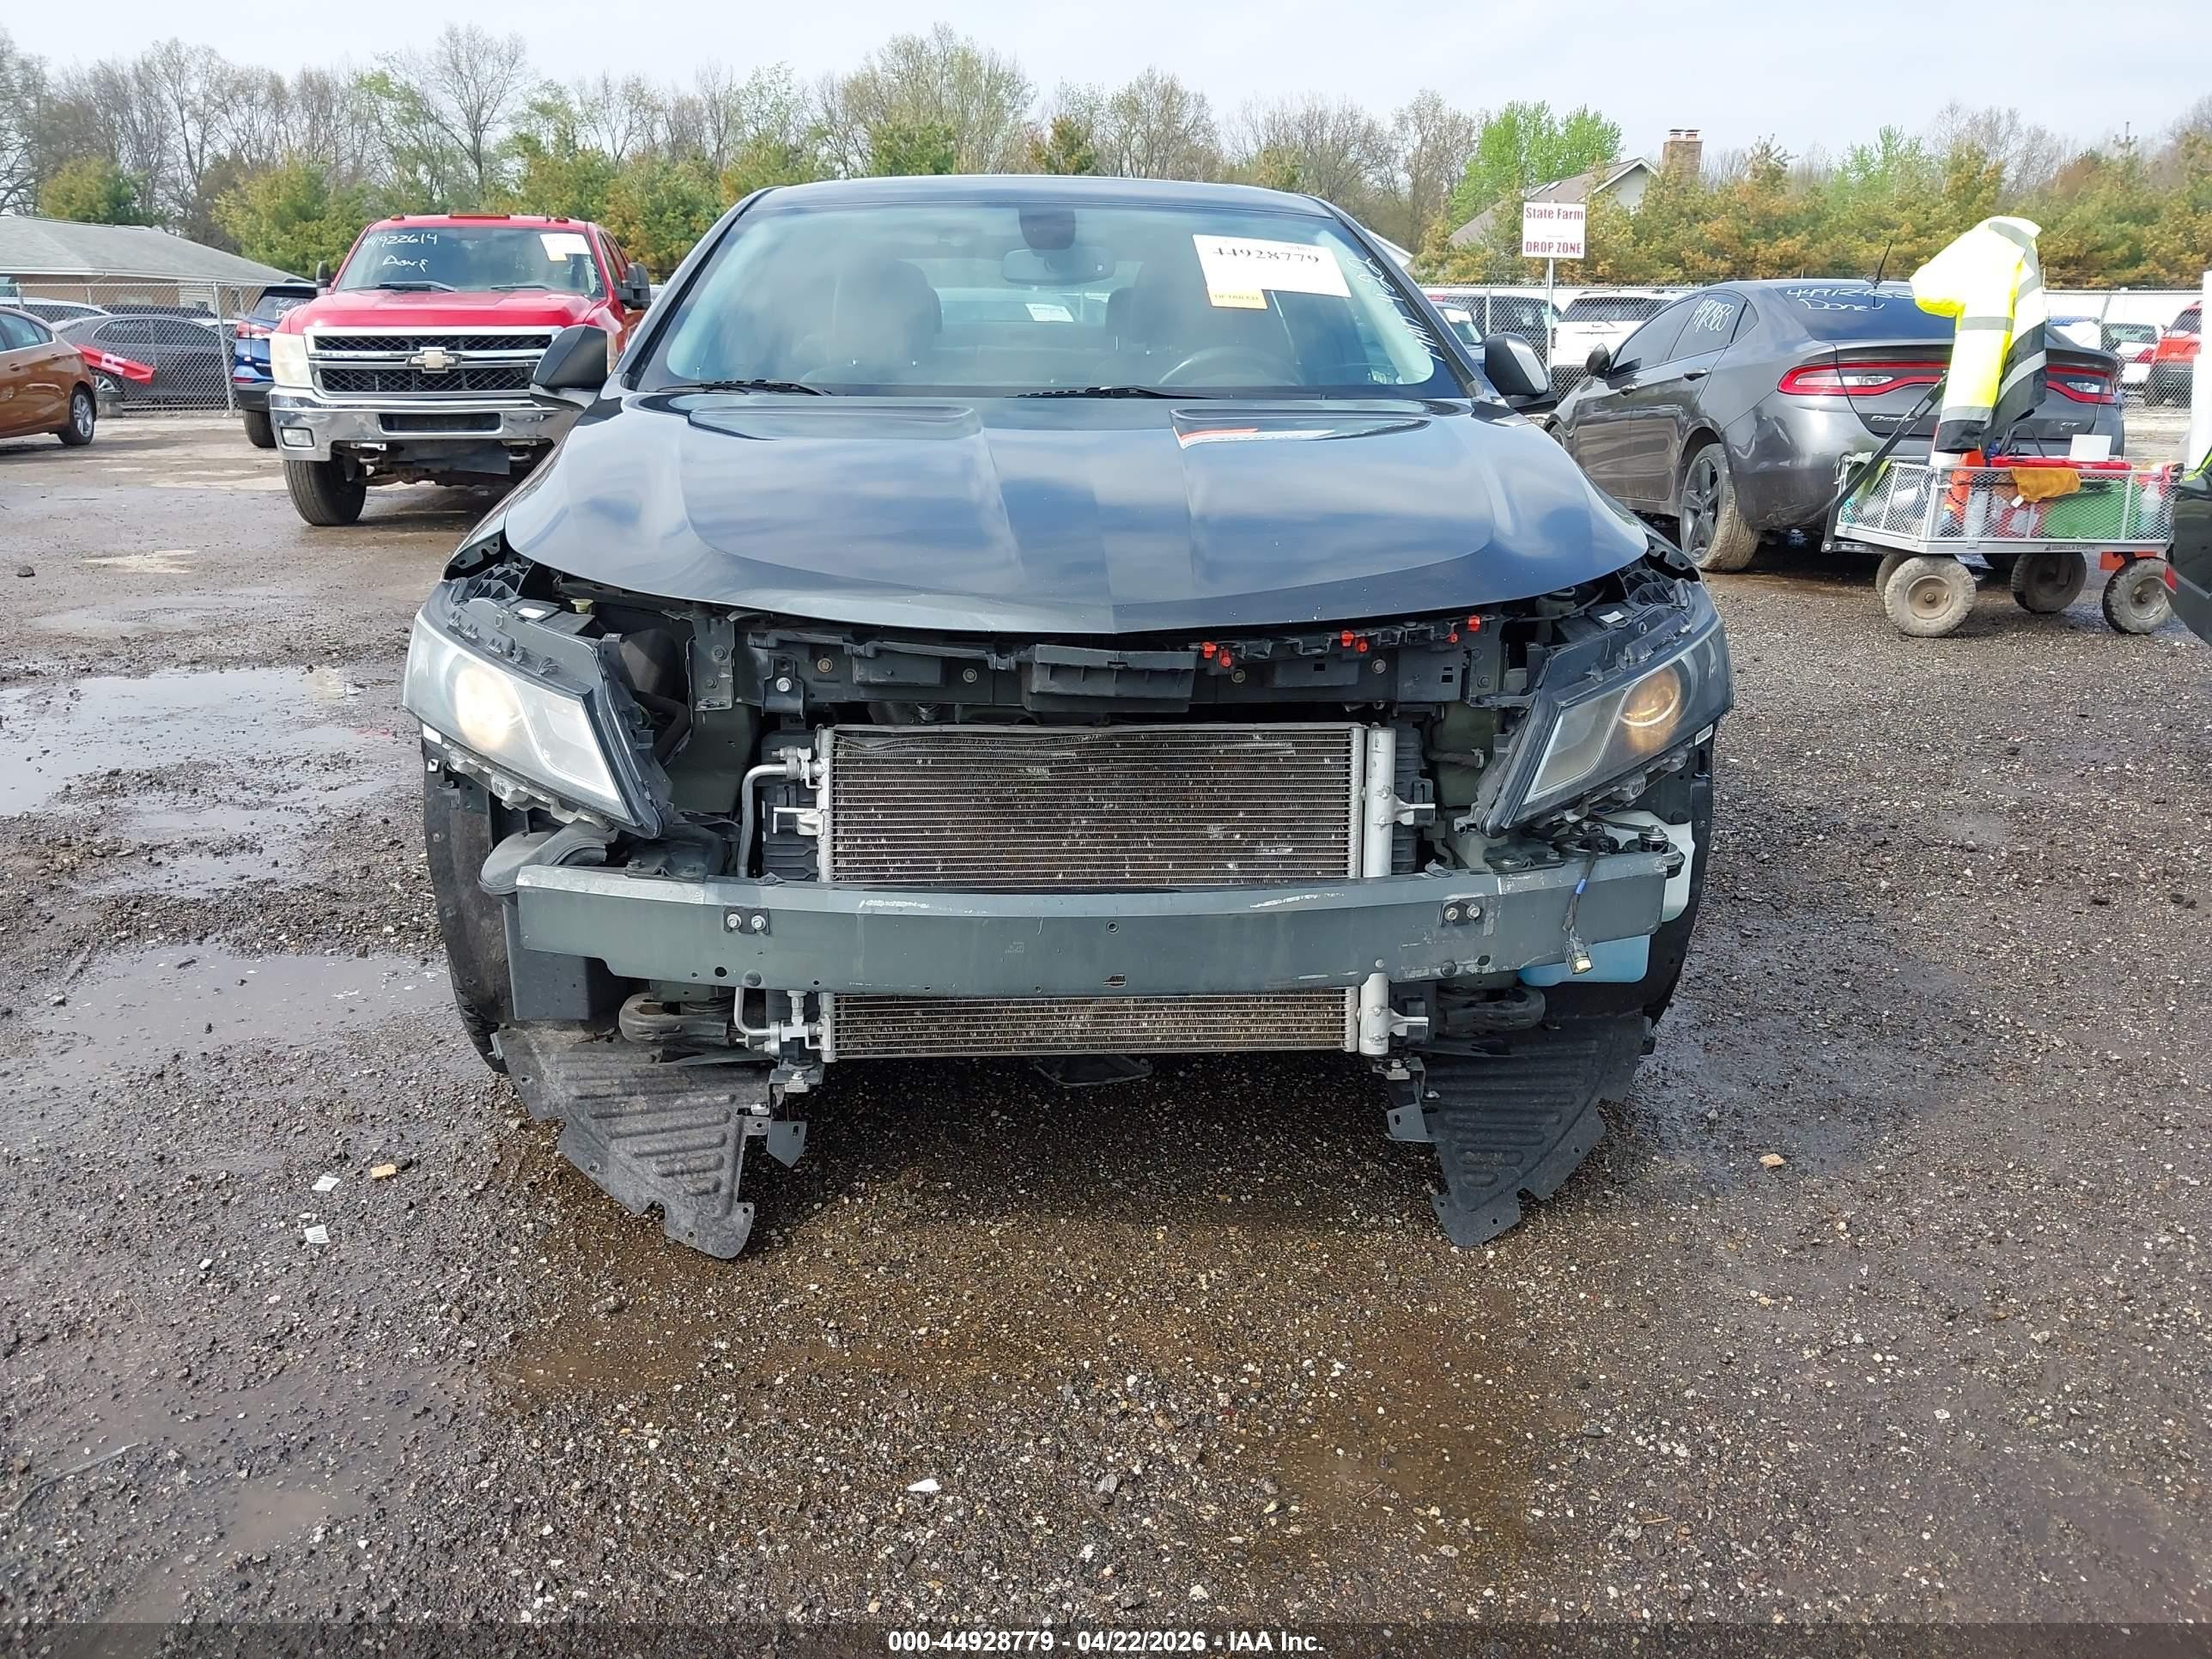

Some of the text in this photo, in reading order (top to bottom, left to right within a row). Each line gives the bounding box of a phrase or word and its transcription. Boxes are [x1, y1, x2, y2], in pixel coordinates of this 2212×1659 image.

[1525, 207, 1583, 221] State Farm
[1212, 246, 1320, 263] 44928779
[1525, 241, 1582, 254] DROP ZONE
